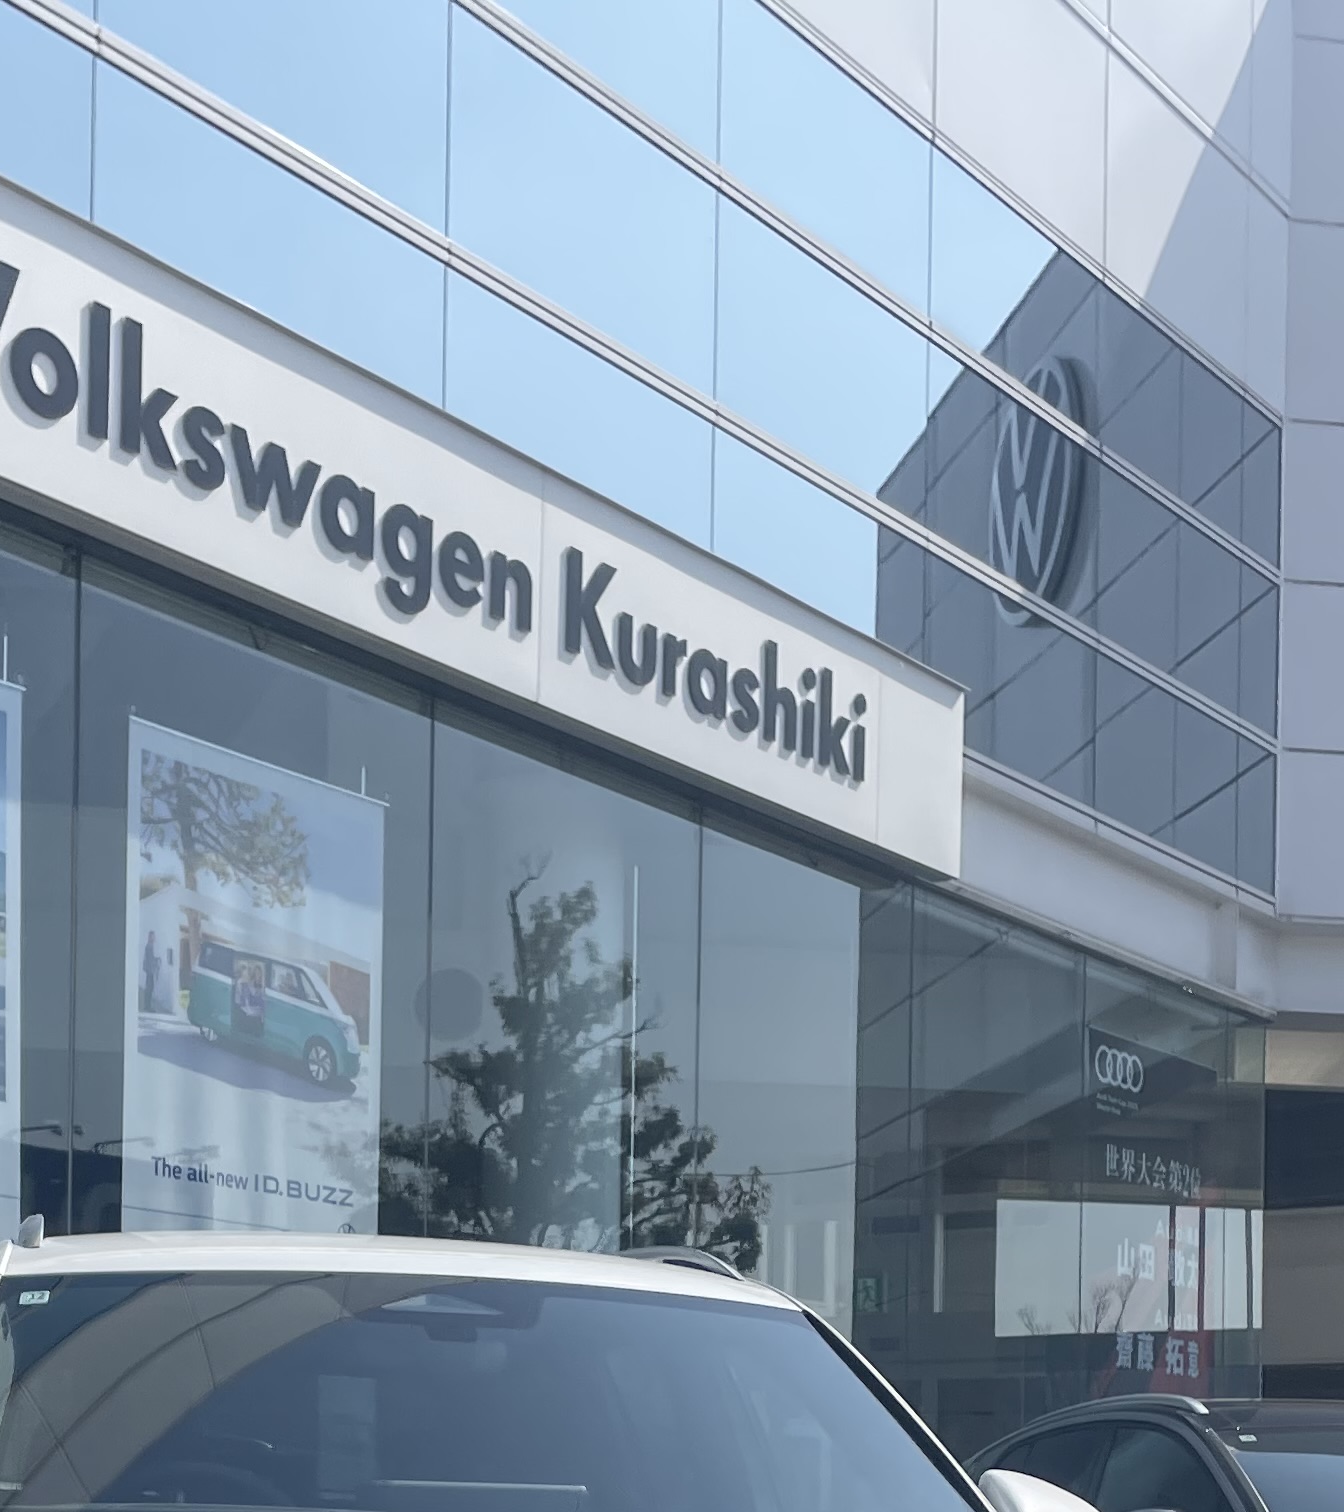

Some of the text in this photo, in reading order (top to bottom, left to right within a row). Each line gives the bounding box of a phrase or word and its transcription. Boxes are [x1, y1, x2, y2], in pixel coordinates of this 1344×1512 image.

[561, 545, 867, 784] Kurashiki
[151, 1156, 182, 1180] The
[187, 1163, 249, 1190] all-new
[1117, 1237, 1155, 1281] 山田
